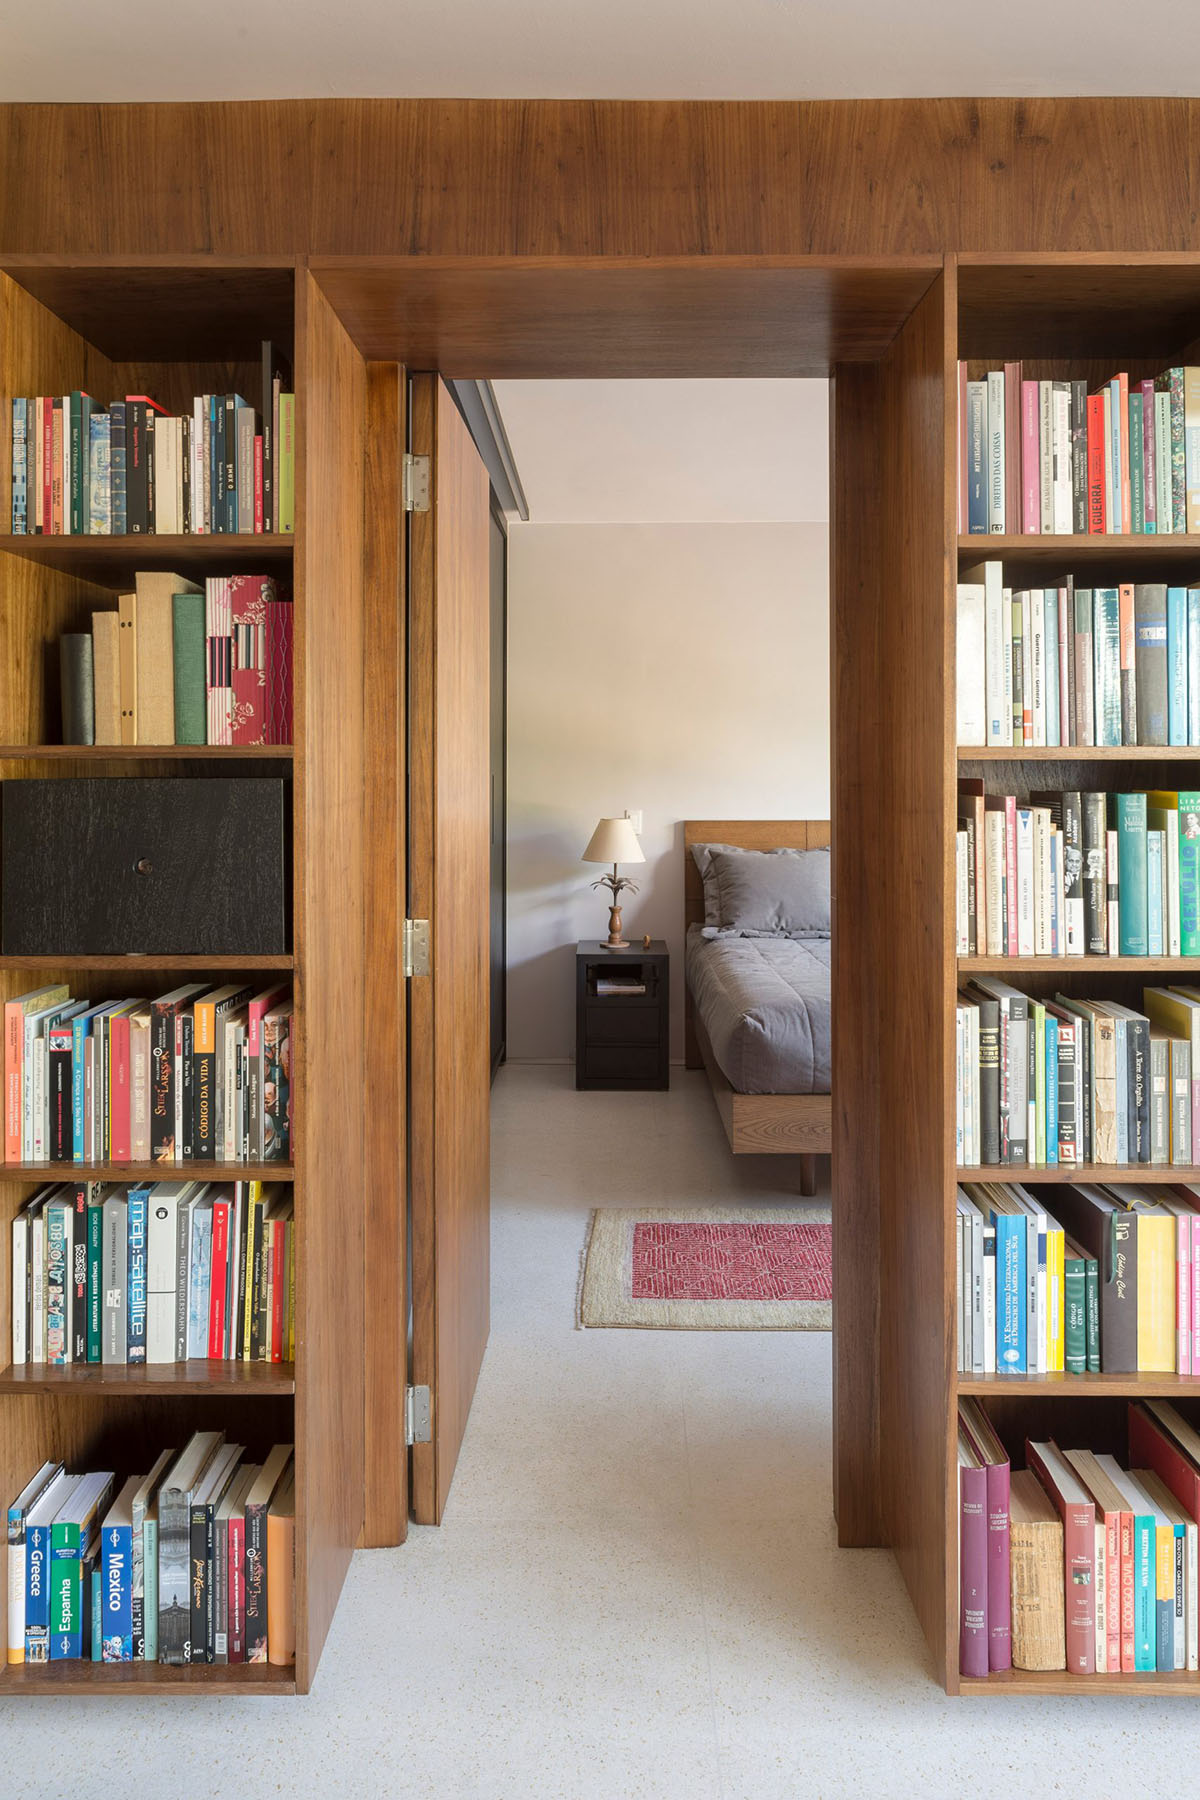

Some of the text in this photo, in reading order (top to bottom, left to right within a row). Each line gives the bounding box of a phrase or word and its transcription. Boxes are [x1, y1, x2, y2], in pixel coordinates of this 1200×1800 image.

[992, 432, 1001, 509] DIREITO DAS COISAS
[1091, 483, 1103, 525] GUERRA
[198, 1058, 208, 1139] CÓDIGO DA VIDA
[1134, 1082, 1142, 1107] Orgulho
[129, 1201, 145, 1335] map:satellite
[178, 1278, 186, 1333] WIEDERSPAHN
[1011, 1296, 1018, 1304] DE
[1004, 1335, 1011, 1343] IX
[1011, 1338, 1018, 1346] DE
[31, 1550, 43, 1597] Greece
[109, 1553, 124, 1612] Mexico
[1107, 1560, 1118, 1630] CÓDIGO CIVIL
[1122, 1560, 1133, 1629] CÓDIGO CIVIL
[1176, 1586, 1182, 1594] DO
[59, 1578, 73, 1632] Espanha
